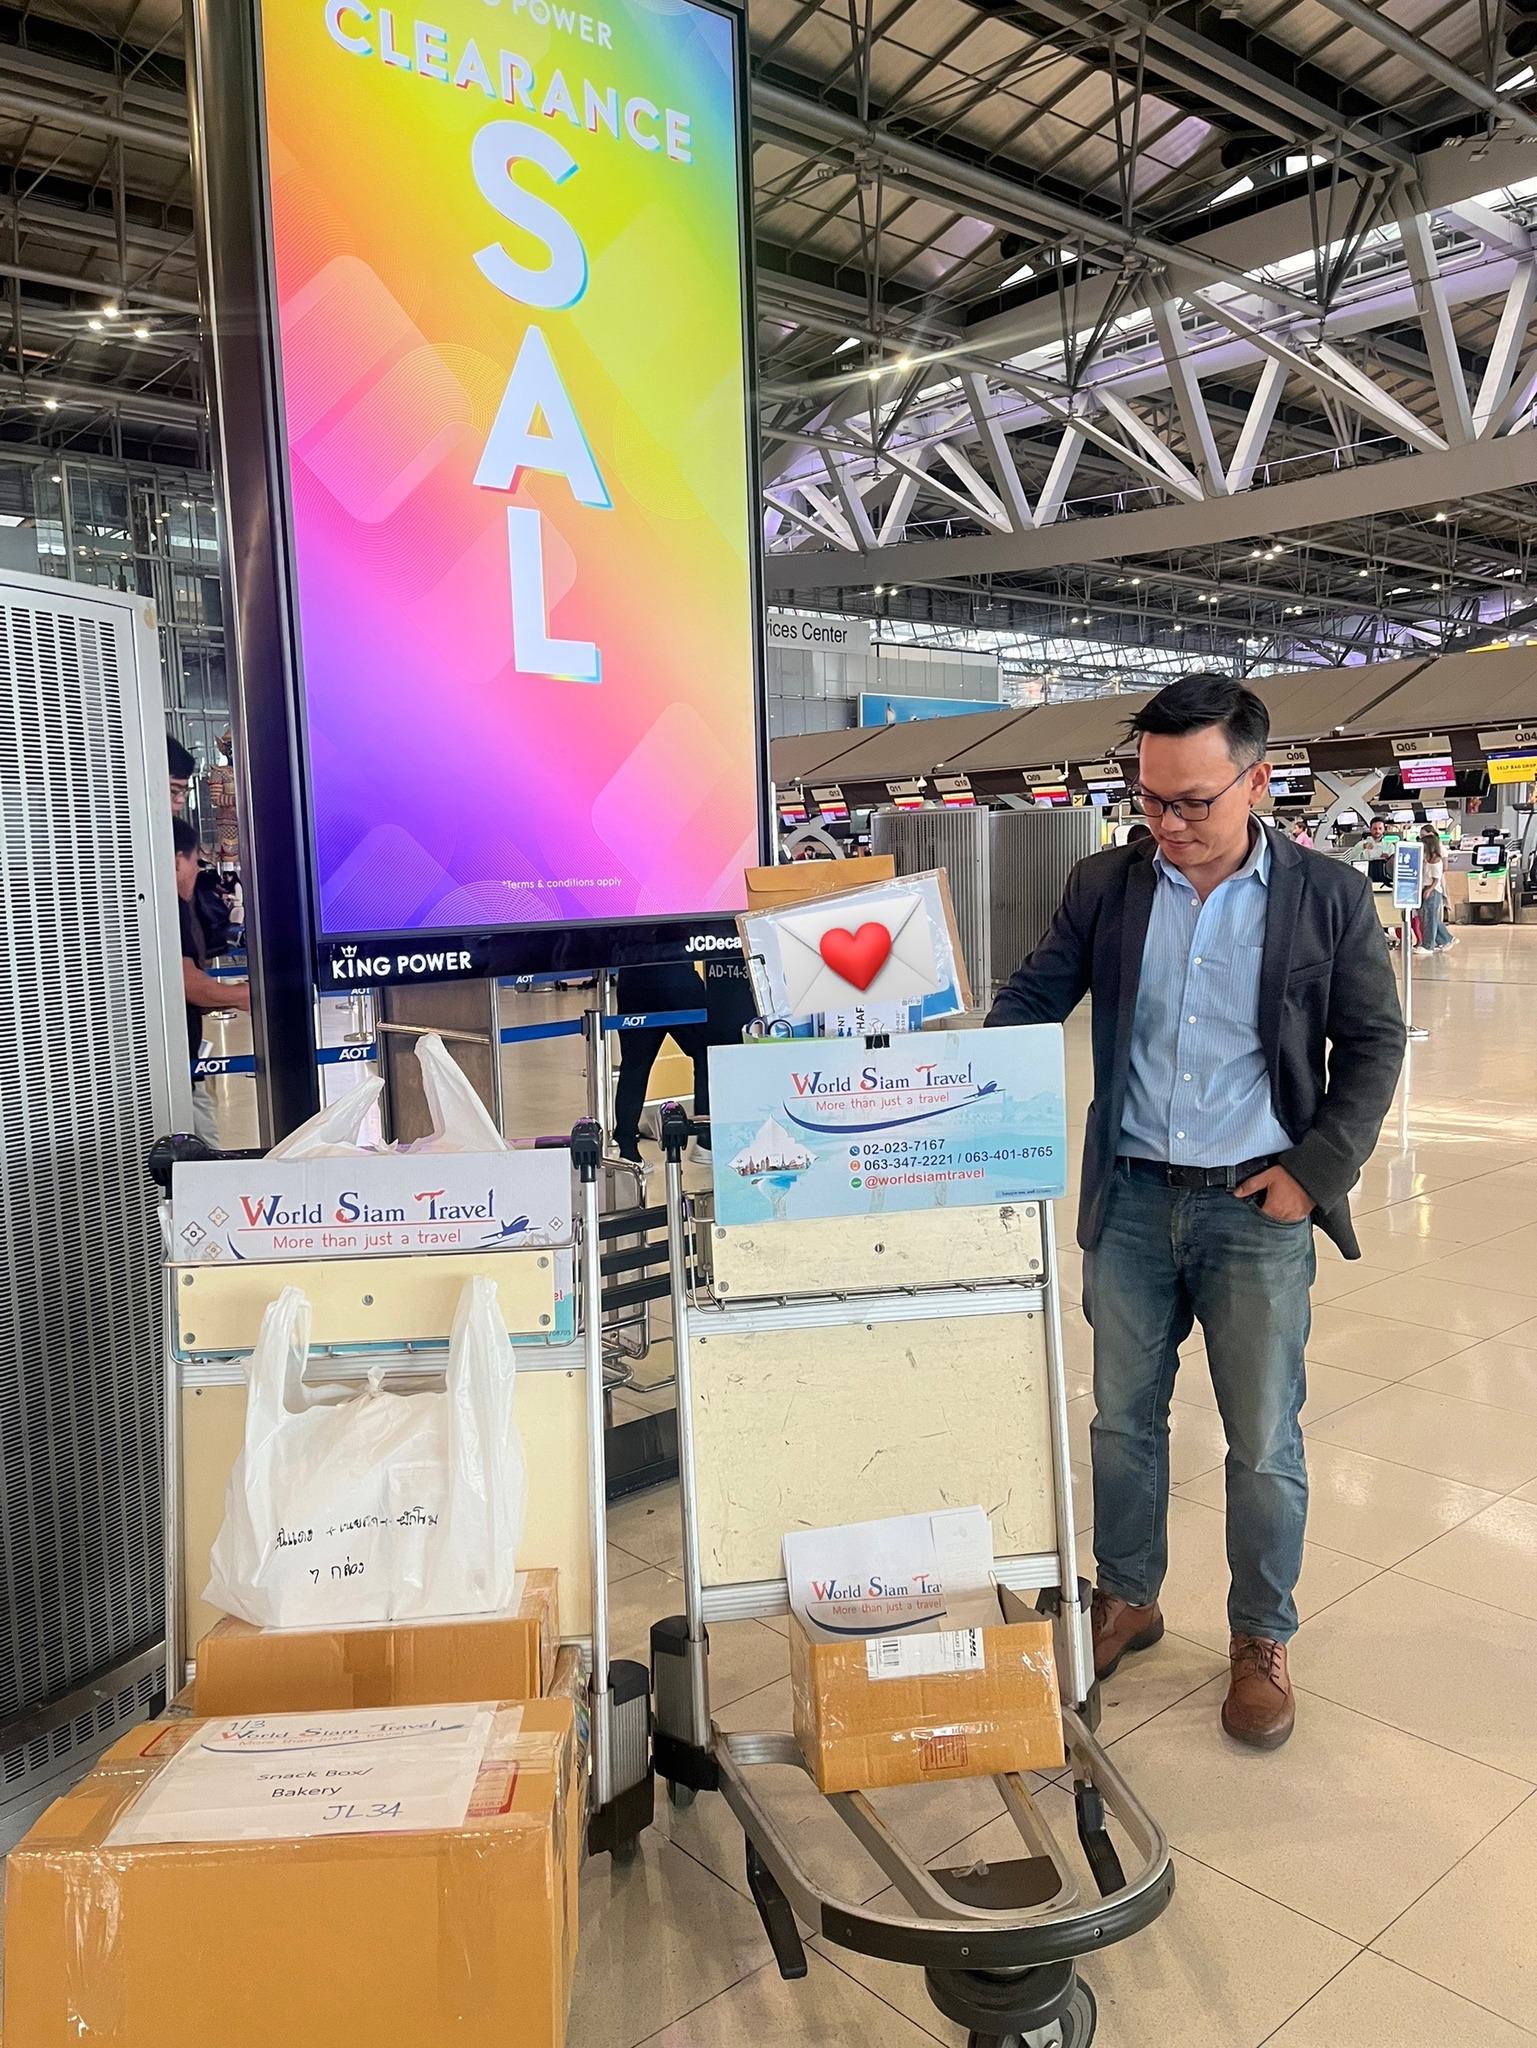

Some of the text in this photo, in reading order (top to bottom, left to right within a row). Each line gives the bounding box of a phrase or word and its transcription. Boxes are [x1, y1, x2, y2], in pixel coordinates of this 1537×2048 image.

[324, 0, 695, 164] CLEARANCE
[801, 622, 848, 643] Center
[1515, 731, 1537, 742] Q04
[1396, 742, 1417, 751] Q05
[1286, 752, 1305, 760] Q06
[1103, 766, 1119, 775] Q08
[537, 880, 544, 889] &
[546, 878, 594, 888] conditions
[596, 877, 622, 888] apply
[332, 951, 472, 979] KING POWER
[515, 974, 534, 984] AOT
[621, 1016, 647, 1027] AOT
[338, 1046, 371, 1061] AOT
[194, 1059, 231, 1074] AOT
[790, 1062, 972, 1095] World Siam Travel
[816, 1092, 950, 1111] More than just a travel
[863, 1139, 946, 1155] 02-023-7167
[864, 1146, 1053, 1171] 063-347-2221 / 063-401-8765
[865, 1168, 985, 1189] @worldsiamtravel
[239, 1188, 494, 1226] World Siam Travel
[273, 1229, 461, 1250] More than just a travel
[811, 1579, 861, 1600] World
[868, 1576, 908, 1597] Siam
[832, 1598, 942, 1615] More than just a travel
[222, 1720, 437, 1740] World Siam Travel
[231, 1720, 265, 1731] 1/3
[271, 1786, 342, 1797] Bakery
